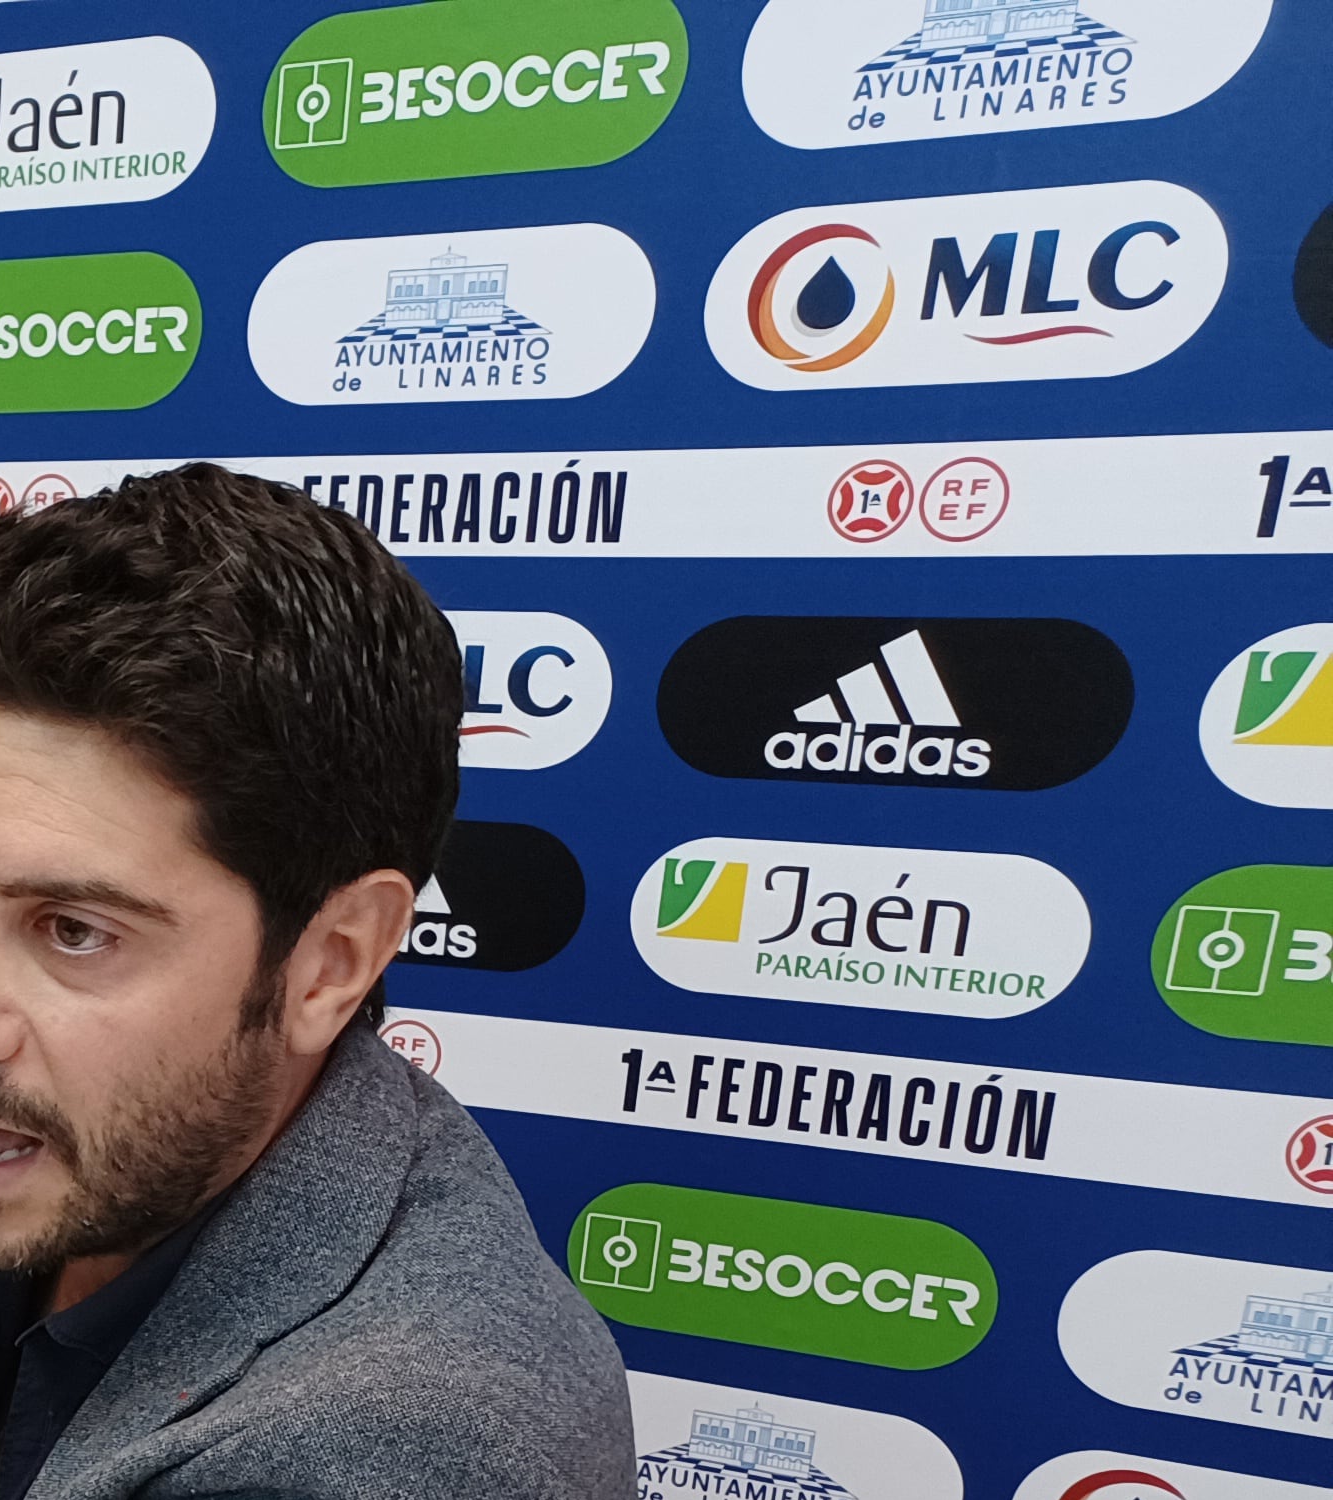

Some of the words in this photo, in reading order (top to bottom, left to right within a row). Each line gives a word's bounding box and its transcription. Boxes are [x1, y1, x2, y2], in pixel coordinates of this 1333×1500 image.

[360, 41, 670, 124] BESOCCER
[853, 47, 1132, 101] AYUNTAMIENTO
[847, 106, 885, 130] de
[934, 78, 1127, 122] LINARES
[72, 150, 186, 182] INTERIOR
[921, 220, 1180, 319] MLC
[333, 373, 361, 392] de
[399, 364, 547, 389] LINARES
[335, 337, 549, 367] AYUNTAMIENTO
[764, 724, 991, 777] adidas
[759, 865, 970, 957] Jaén
[756, 951, 889, 986] PARAÍSO
[894, 963, 1045, 999] INTERIOR
[686, 1053, 1057, 1162] FEDERACIÓN
[668, 1238, 979, 1327] BESOCCER
[1163, 1382, 1202, 1404] de
